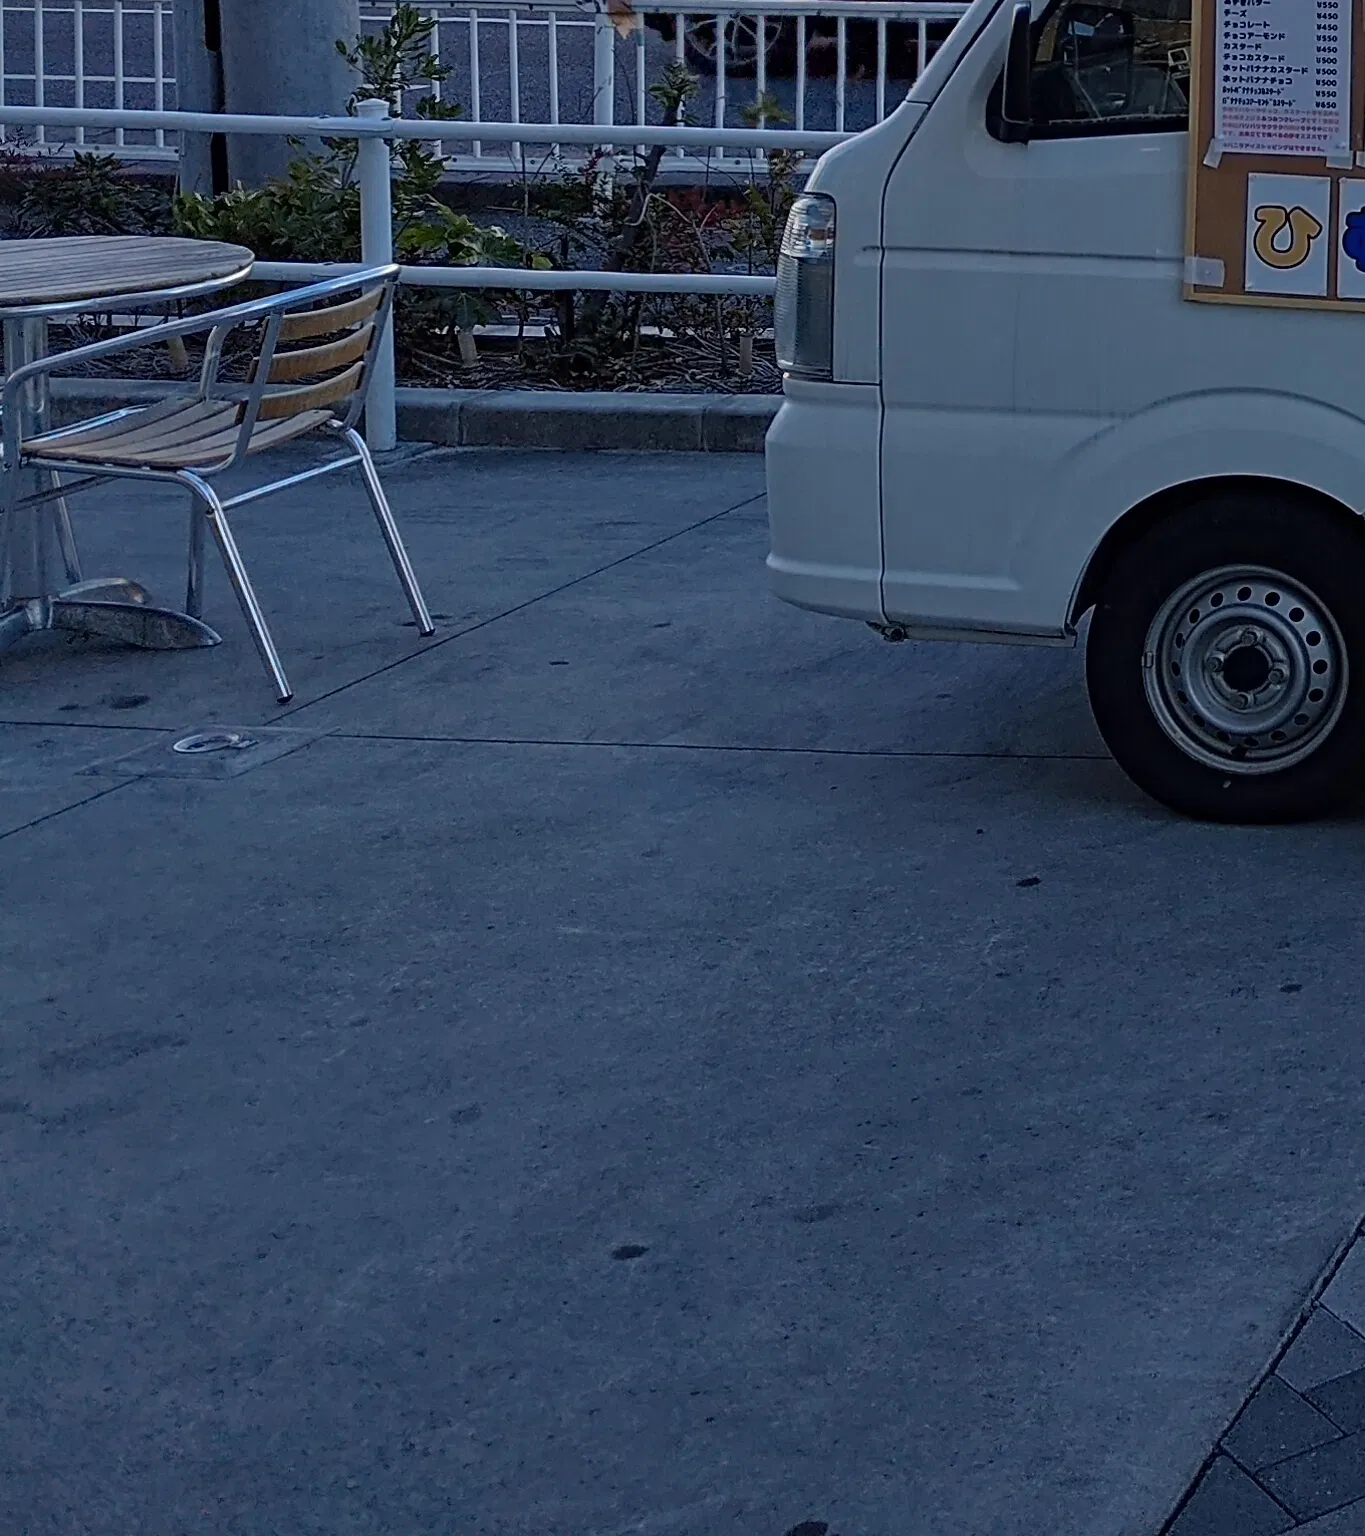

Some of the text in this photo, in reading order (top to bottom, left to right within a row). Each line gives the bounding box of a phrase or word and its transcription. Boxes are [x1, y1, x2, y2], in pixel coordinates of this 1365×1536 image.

[1224, 9, 1248, 18] チーズ
[1224, 21, 1270, 29] チョコレート
[1223, 32, 1286, 41] チョコアーモンド
[1223, 43, 1262, 51] カスタード
[1222, 53, 1285, 63] チョコカスタード
